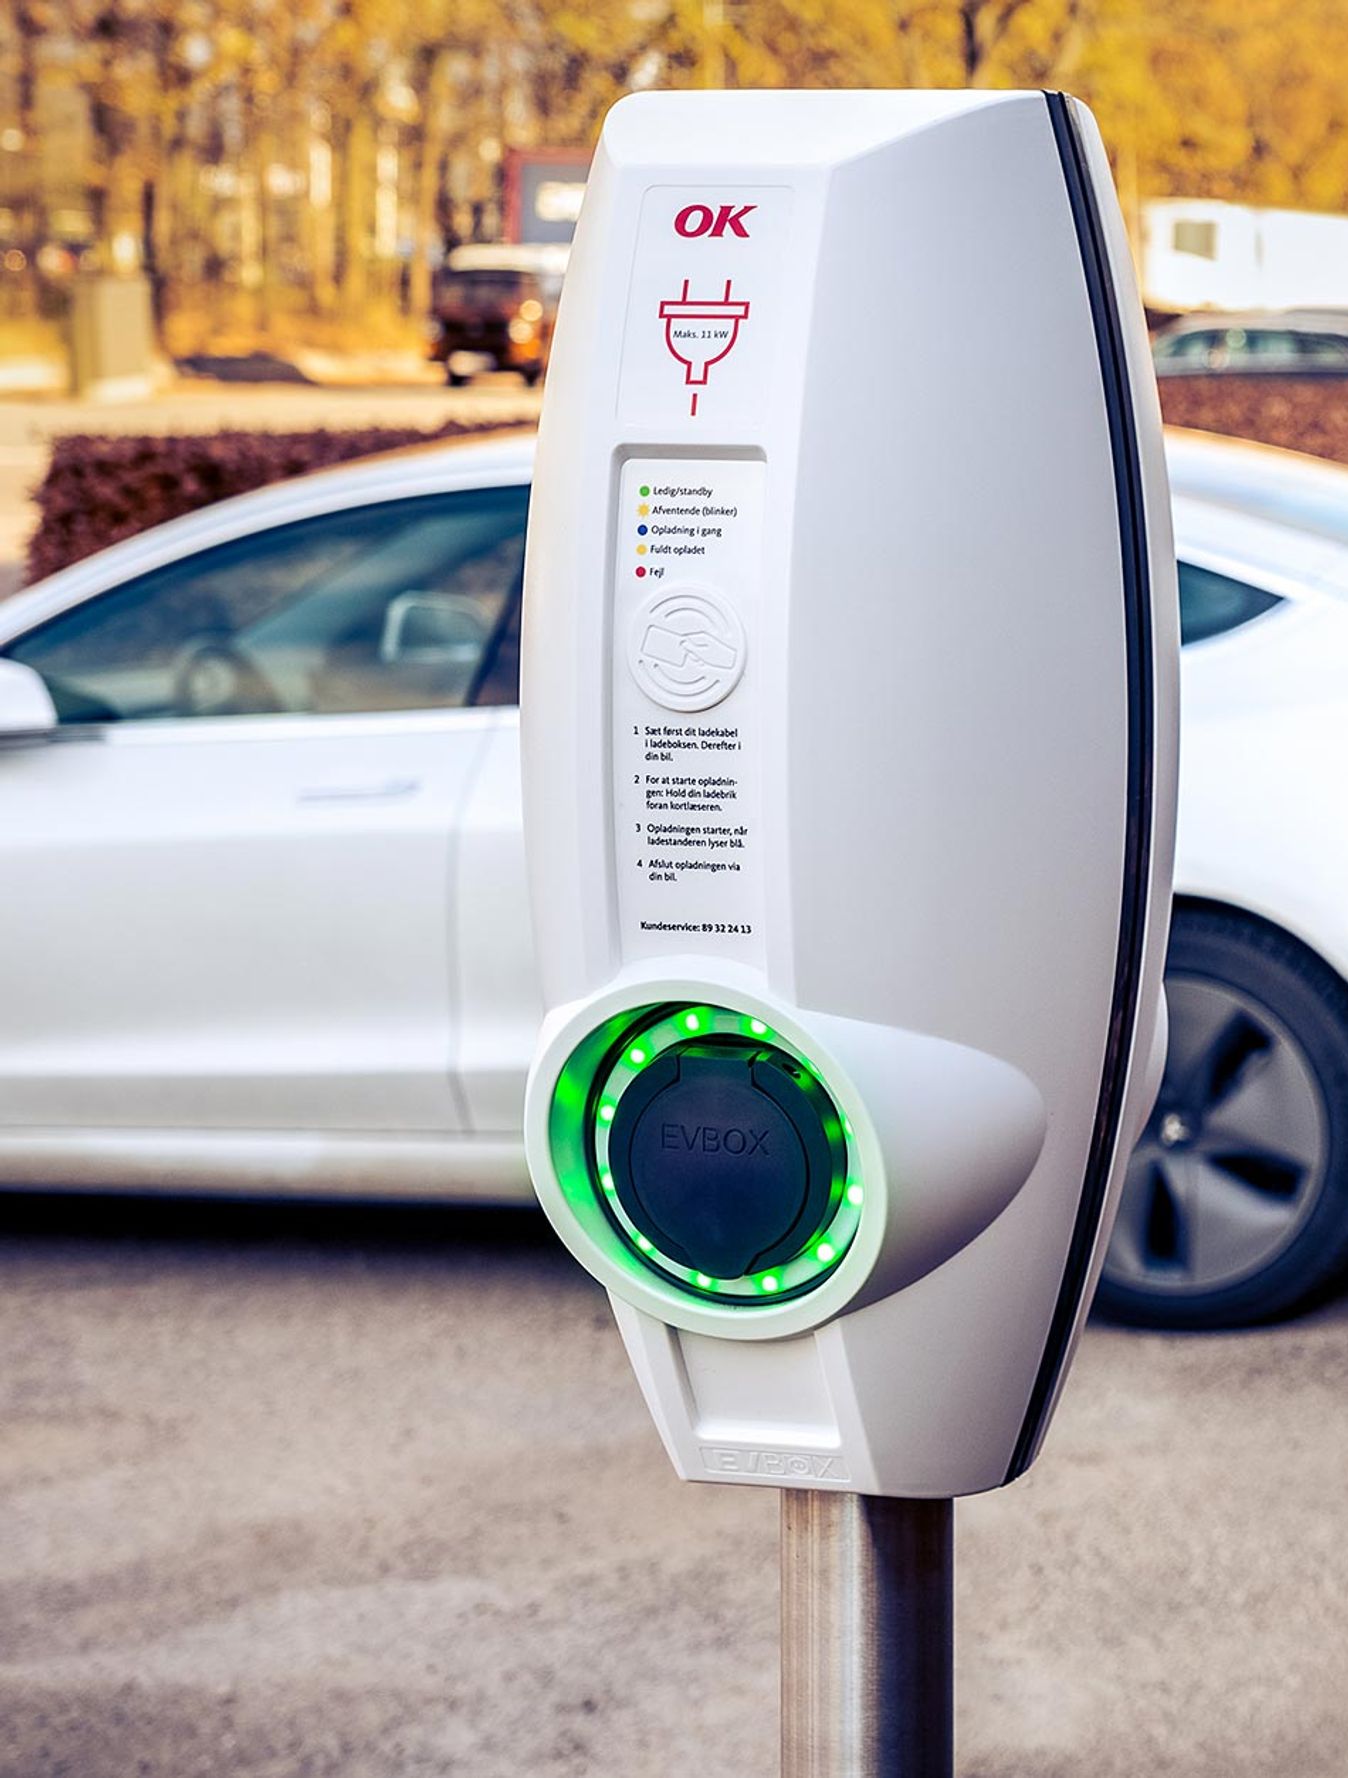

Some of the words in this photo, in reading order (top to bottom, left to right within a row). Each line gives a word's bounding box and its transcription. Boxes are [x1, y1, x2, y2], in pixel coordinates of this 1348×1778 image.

[674, 204, 758, 238] OK
[673, 330, 699, 339] Maks.
[701, 330, 712, 339] 11
[713, 330, 729, 339] kW
[653, 486, 713, 498] Ledig/standby
[652, 505, 700, 516] Afventende
[702, 506, 738, 517] (blinker)
[651, 525, 695, 537] Opladning
[701, 528, 722, 537] gang
[650, 544, 672, 554] Fuldt
[673, 545, 705, 556] opladet
[649, 567, 665, 578] Fejl
[645, 726, 661, 736] Sæt
[663, 726, 683, 736] først
[684, 727, 697, 737] dit
[698, 727, 738, 737] ladekabel
[650, 739, 699, 749] ladeboksen.
[701, 741, 736, 750] Derefter
[645, 752, 659, 761] din
[660, 752, 674, 761] bil.
[645, 775, 659, 784] For
[661, 777, 670, 785] at
[671, 776, 696, 786] starte
[698, 777, 738, 787] opladnin-
[646, 790, 663, 799] gen:
[665, 789, 686, 798] Hold
[688, 789, 701, 798] din
[703, 790, 737, 799] ladebrik
[646, 801, 668, 810] foran
[670, 801, 722, 811] kortlæseren.
[647, 823, 701, 836] Opladningen
[702, 826, 732, 836] starter,
[733, 826, 748, 836] når
[647, 836, 706, 847] ladestanderen
[708, 838, 728, 849] lyser
[729, 839, 745, 848] blå.
[649, 859, 673, 869] Afslut
[675, 860, 726, 872] opladningen
[728, 862, 740, 871] via
[649, 872, 663, 881] din
[664, 873, 678, 881] bil.
[640, 921, 700, 932] Kundeservice:
[701, 923, 713, 933] 89
[715, 923, 726, 933] 32
[727, 924, 739, 933] 24
[740, 924, 752, 934] 13
[660, 1123, 770, 1156] EVBOX
